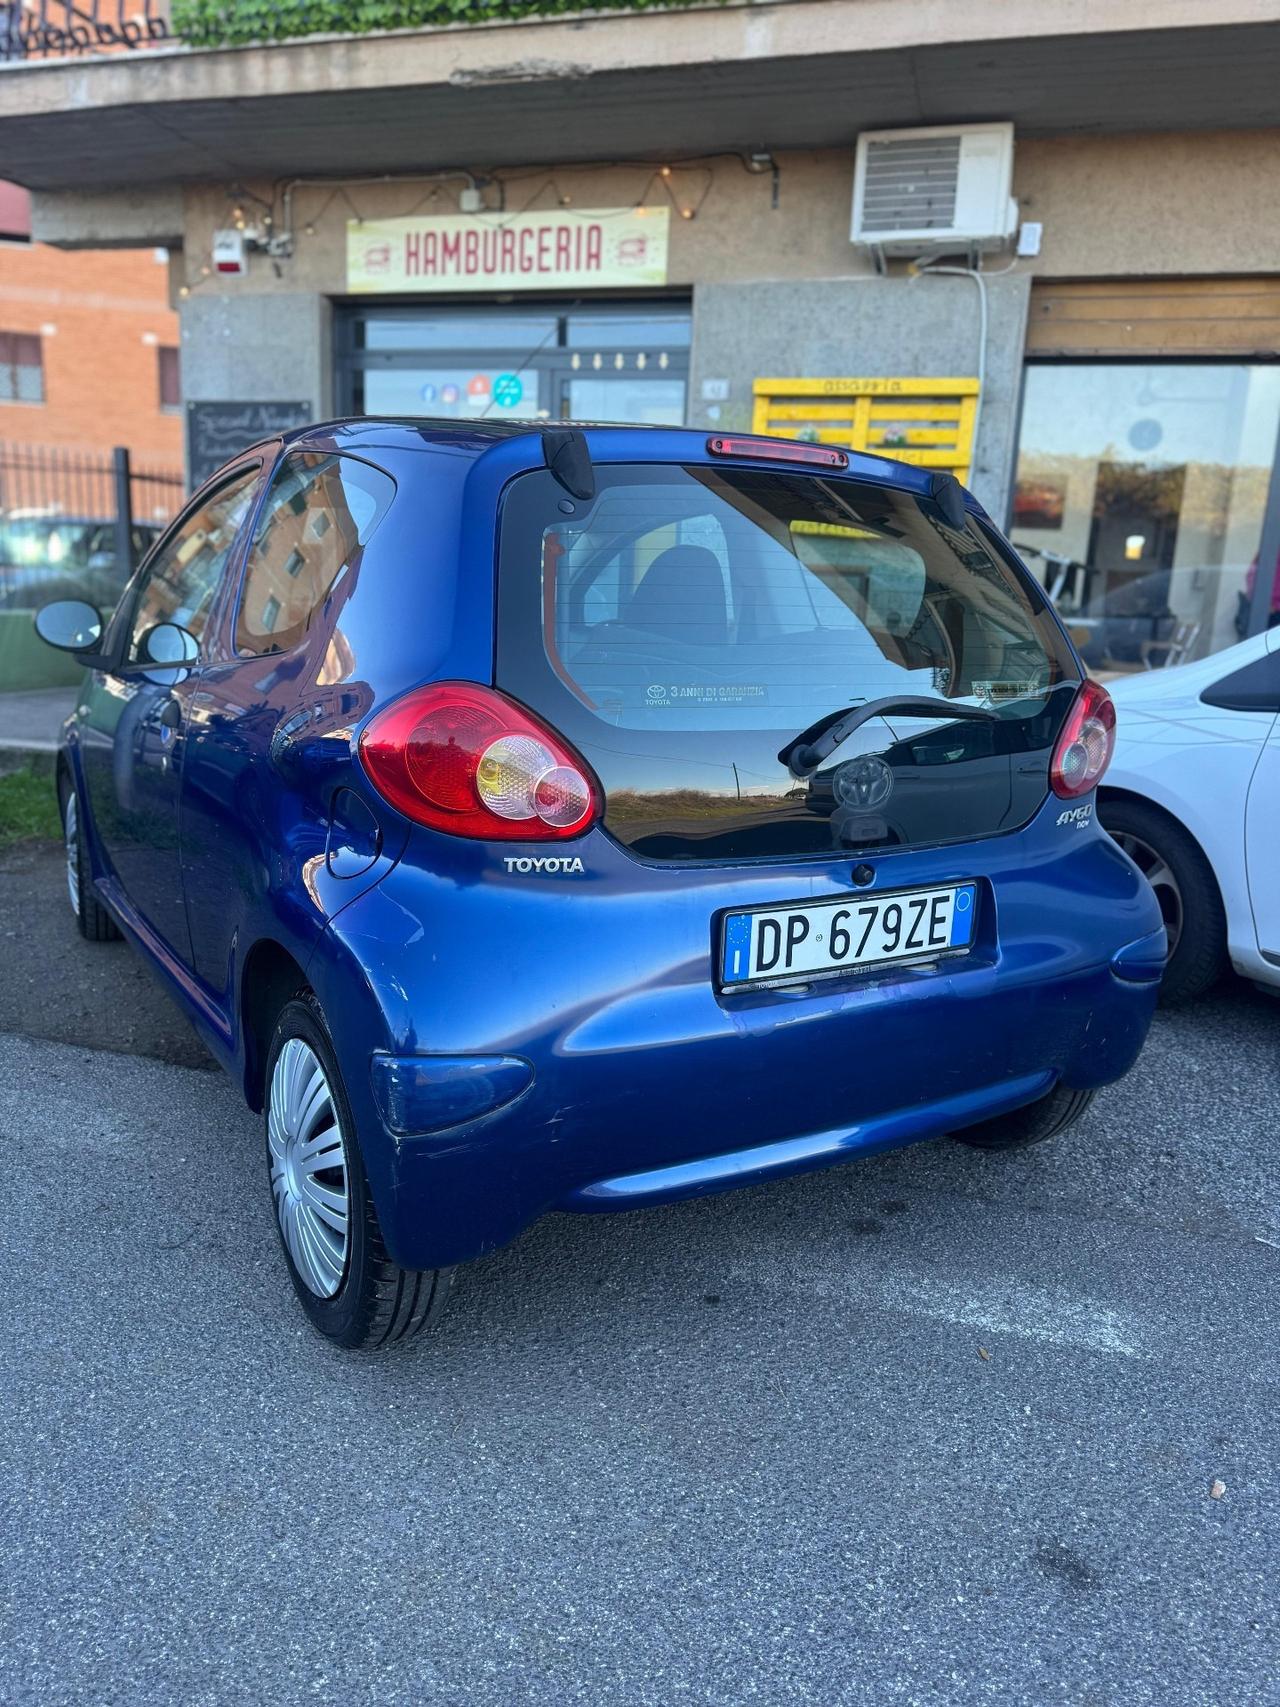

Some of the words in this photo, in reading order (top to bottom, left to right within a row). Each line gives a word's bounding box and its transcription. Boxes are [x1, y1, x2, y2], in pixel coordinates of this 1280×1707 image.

[406, 225, 602, 276] HAMBURGERIA
[670, 686, 678, 697] 3
[503, 857, 585, 873] TOYOTA
[756, 914, 810, 972] DP
[829, 895, 950, 959] 679ZE
